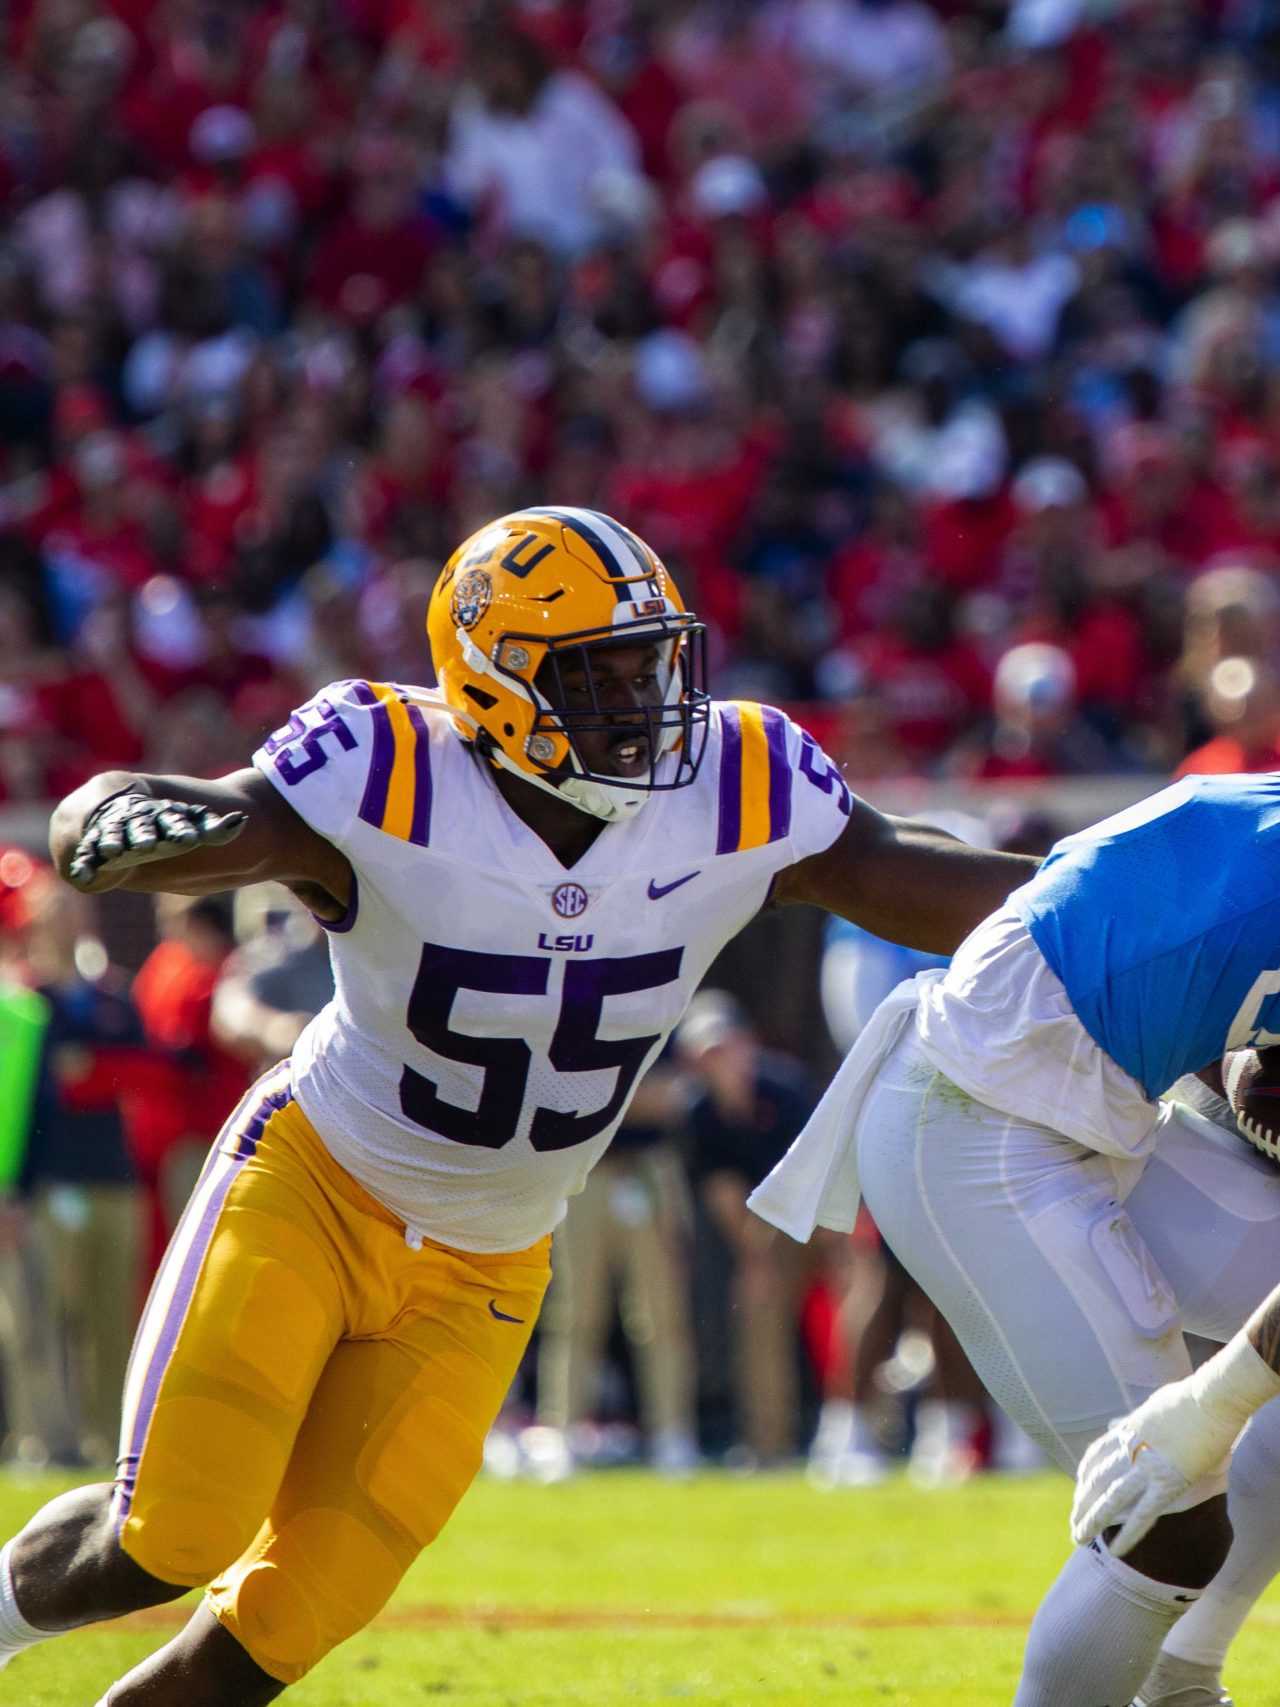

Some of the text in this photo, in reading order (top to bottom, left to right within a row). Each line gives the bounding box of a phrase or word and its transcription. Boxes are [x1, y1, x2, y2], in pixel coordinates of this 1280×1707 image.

[630, 598, 666, 619] LSU
[553, 885, 588, 917] SEC
[537, 933, 594, 952] LSU
[399, 942, 686, 1152] 55
